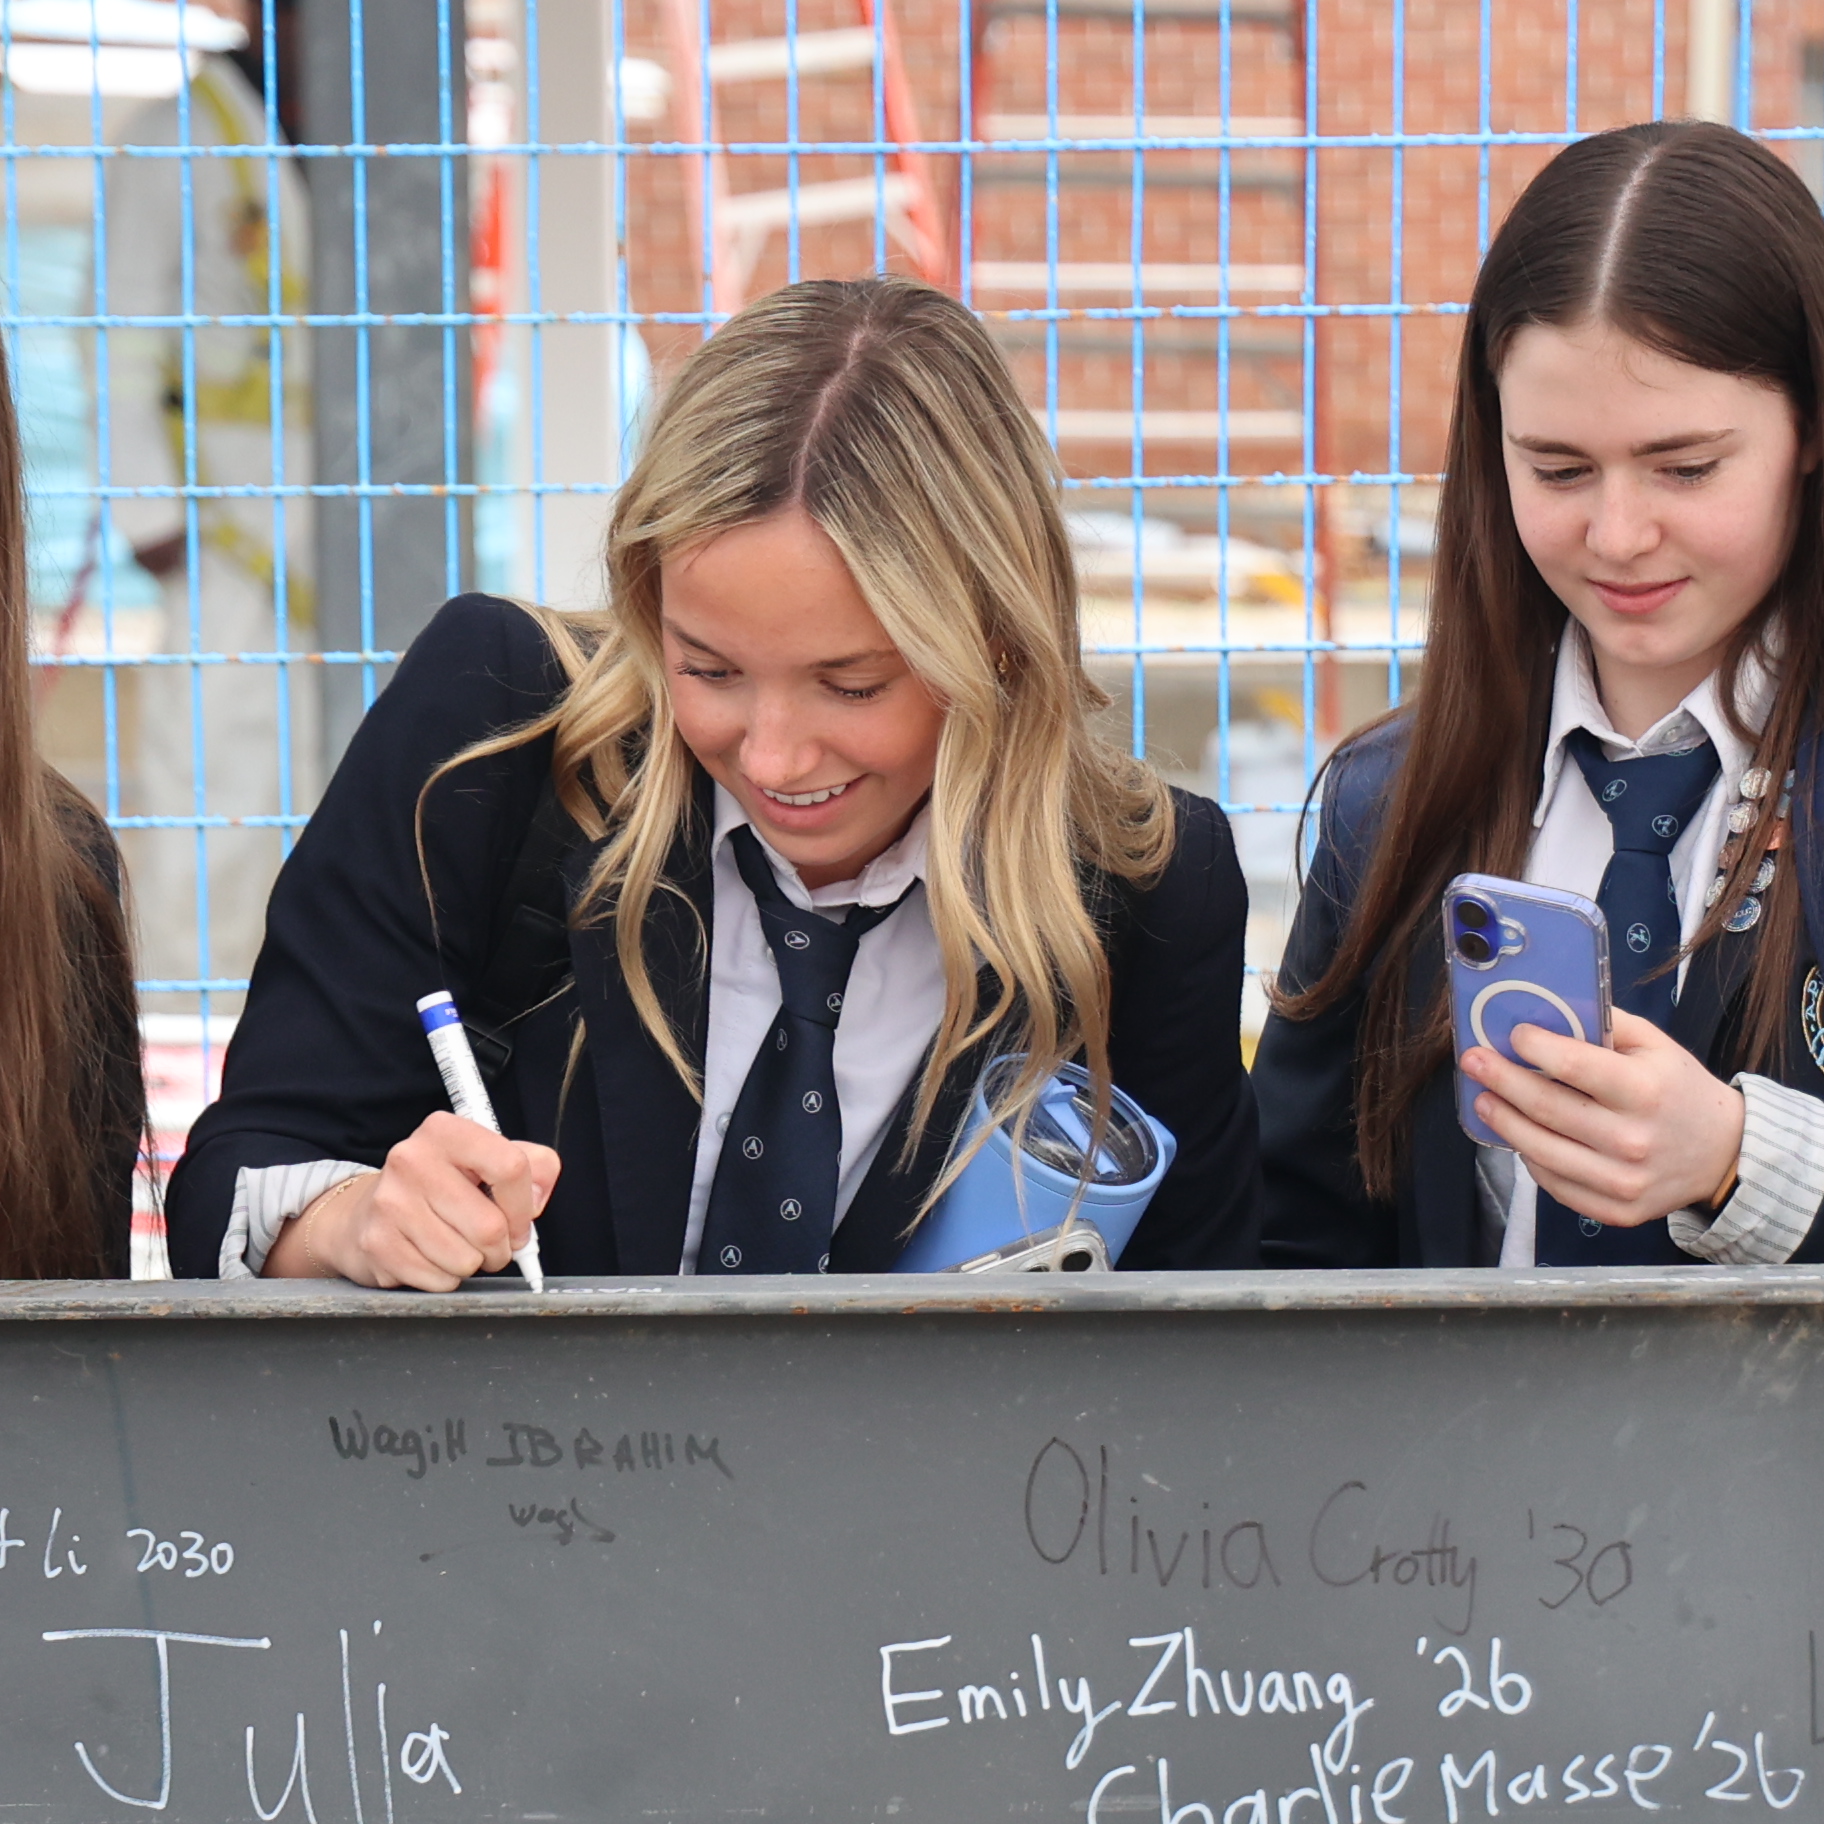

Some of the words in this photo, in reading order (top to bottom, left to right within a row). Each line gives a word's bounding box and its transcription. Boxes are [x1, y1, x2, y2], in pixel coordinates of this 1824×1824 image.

[876, 1632, 1122, 1772] Emily
[1125, 1624, 1376, 1776] Zhuang
[1417, 1637, 1532, 1717] '26
